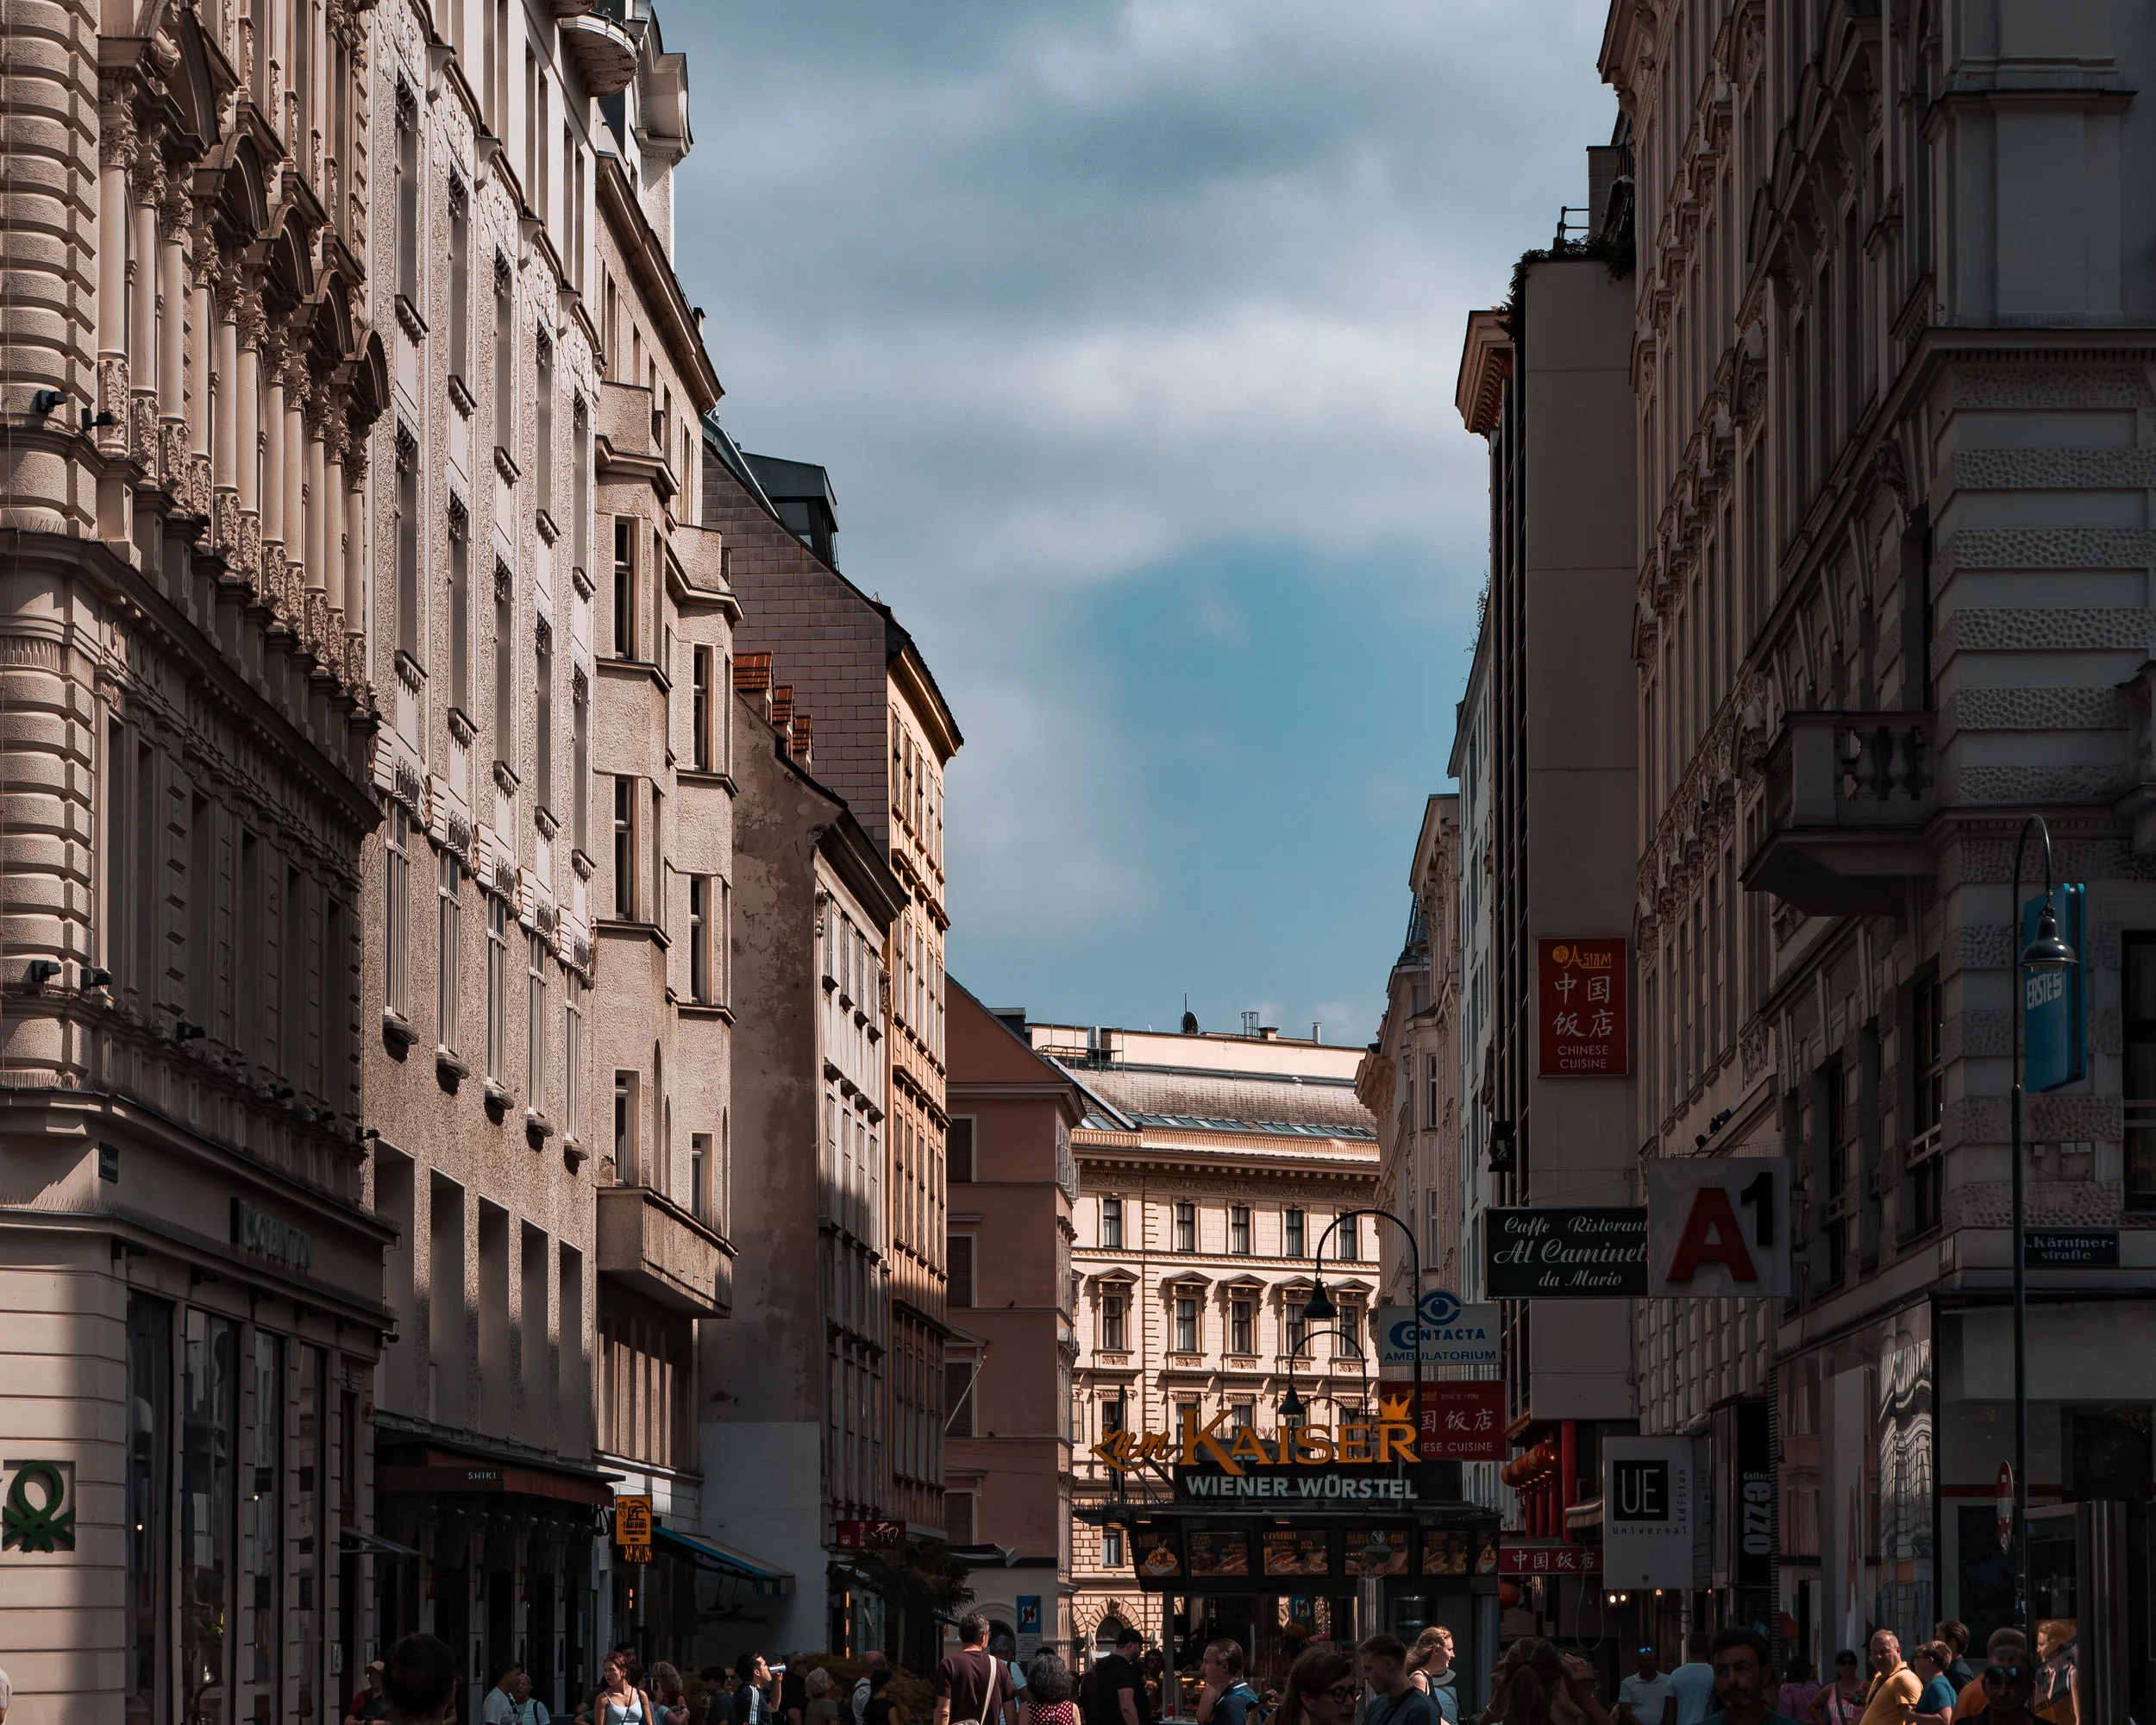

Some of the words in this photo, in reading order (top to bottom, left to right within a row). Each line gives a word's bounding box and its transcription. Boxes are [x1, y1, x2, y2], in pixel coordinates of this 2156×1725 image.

[1554, 972, 1611, 1005] 中国
[1551, 1008, 1614, 1038] 饭店
[1557, 1045, 1608, 1055] CHINESE
[1559, 1058, 1607, 1069] CUISINE
[1503, 1215, 1551, 1237] Caffe
[1666, 1172, 1773, 1283] A1
[1493, 1239, 1533, 1264] Al
[1538, 1270, 1560, 1287] da
[1564, 1270, 1622, 1287] Mario
[1389, 1320, 1486, 1350] CONTACTA
[1411, 1408, 1493, 1433] 国饭店
[1177, 1409, 1422, 1476] KAISER
[1447, 1441, 1493, 1452] CUISINE
[467, 1471, 497, 1480] SHIKI
[1185, 1476, 1288, 1497] WIENER
[1298, 1474, 1420, 1500] WÜRSTEL
[1621, 1468, 1660, 1514] UE
[1677, 1469, 1686, 1521] Edition
[1613, 1526, 1686, 1534] Universal
[1512, 1550, 1595, 1571] 中国饭店
